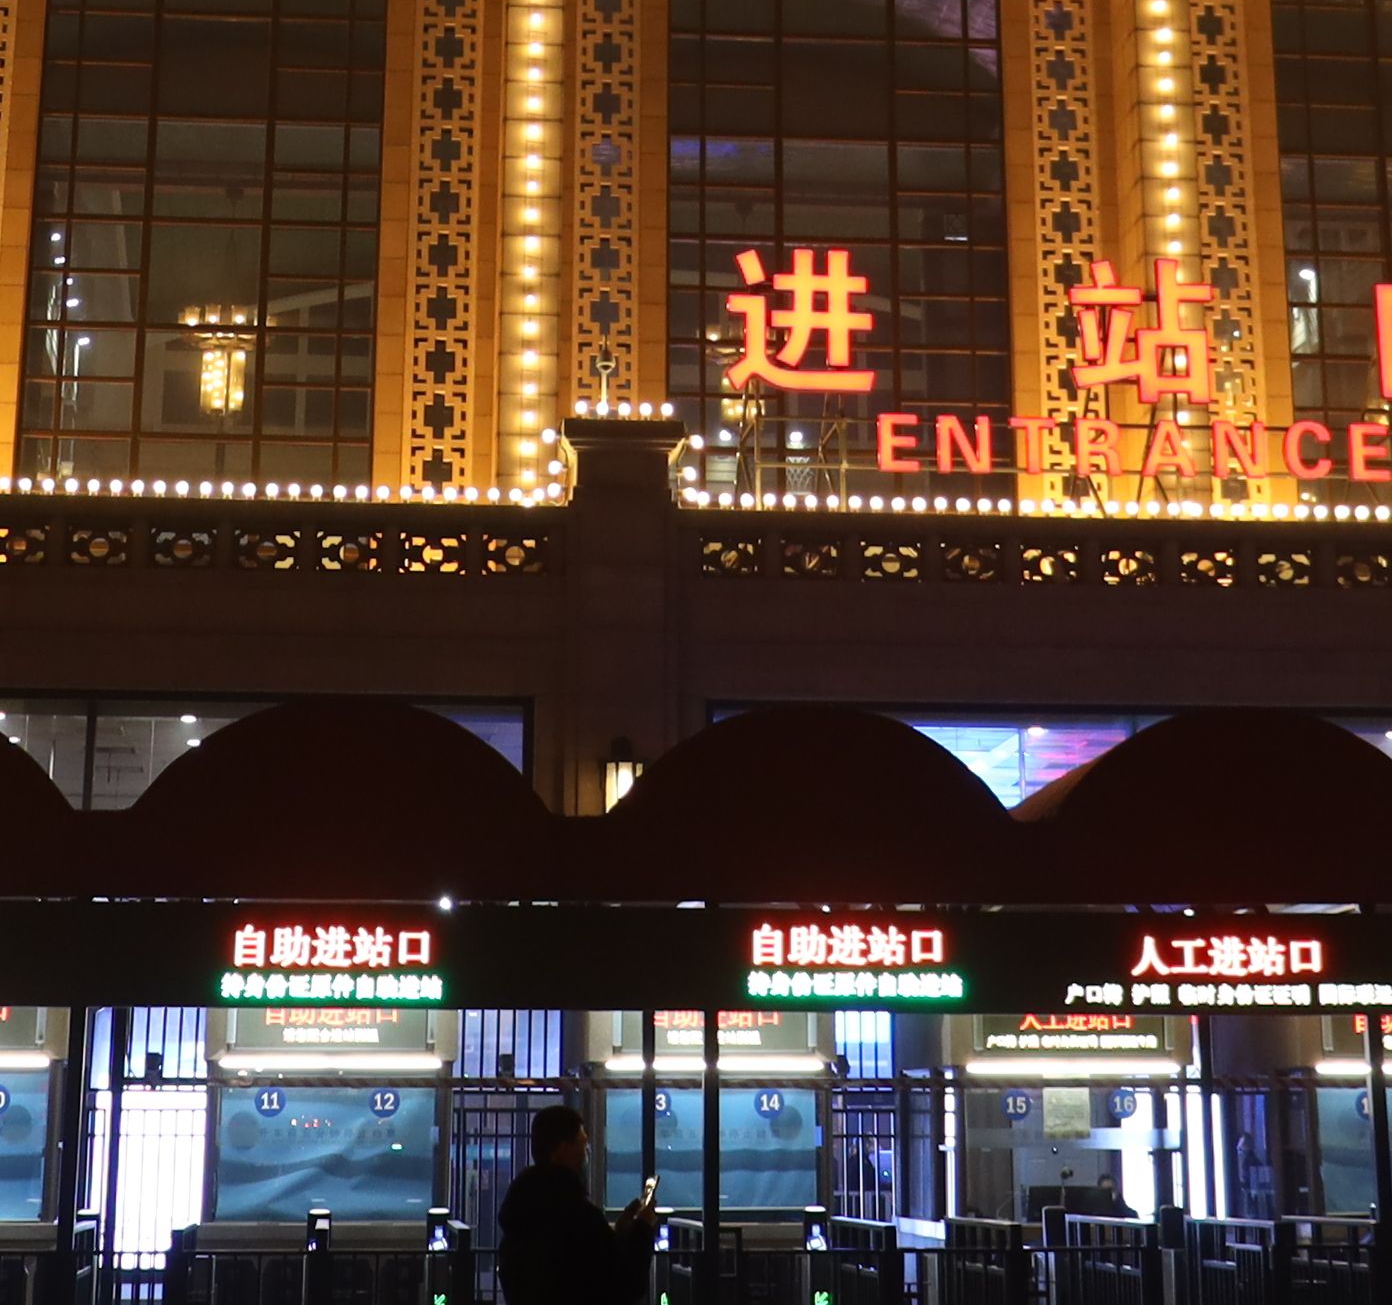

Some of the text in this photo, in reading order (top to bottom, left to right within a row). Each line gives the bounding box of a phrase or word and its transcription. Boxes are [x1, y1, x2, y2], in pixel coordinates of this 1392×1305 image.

[725, 248, 876, 393] 进
[1068, 258, 1214, 404] 站
[234, 924, 430, 967] 自助进站口
[752, 923, 942, 966] 自助进站口
[1131, 936, 1323, 976] 人工进站口
[260, 1092, 280, 1110] 11
[374, 1093, 395, 1111] 12
[655, 1094, 667, 1111] 3
[760, 1094, 781, 1112] 14
[1006, 1096, 1027, 1114] 15
[1113, 1095, 1134, 1113] 16
